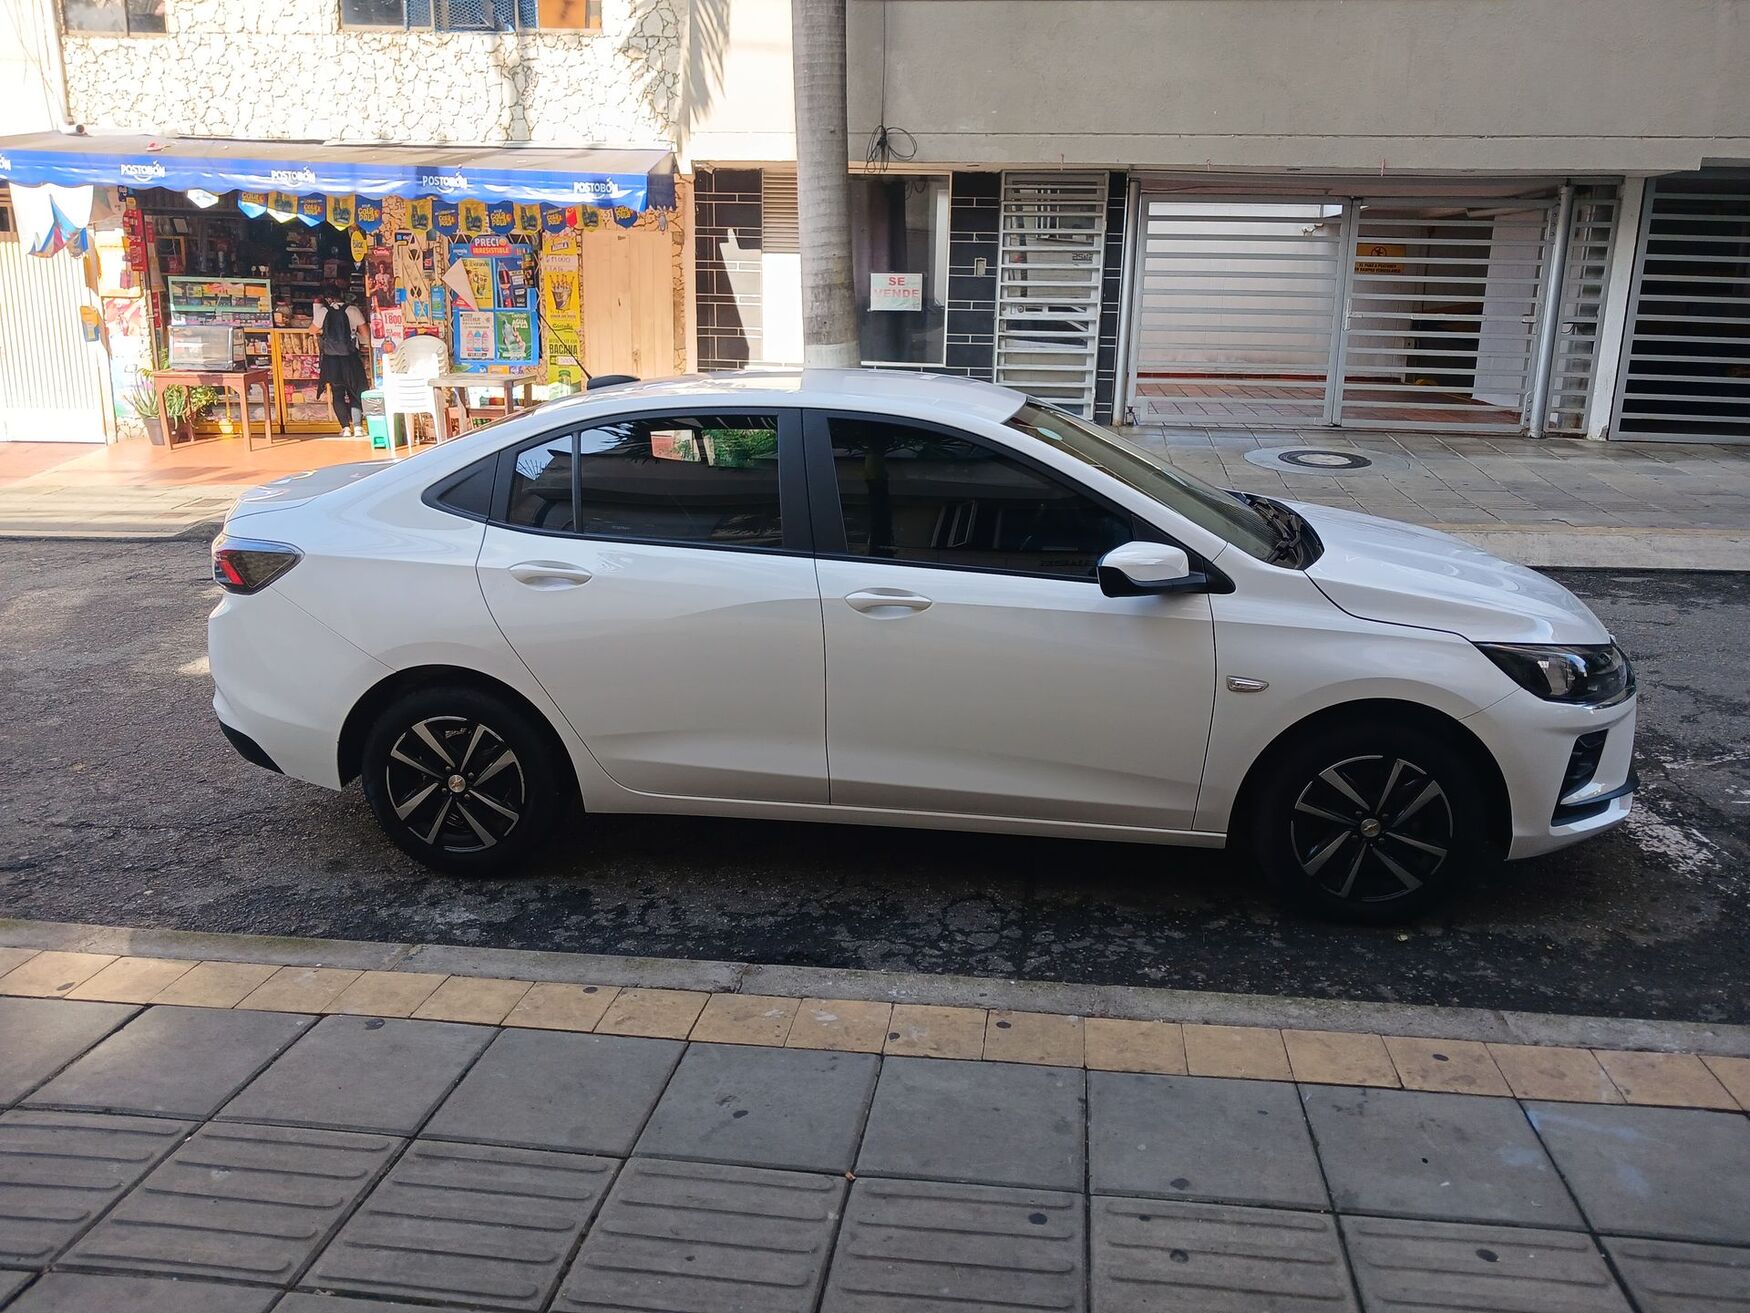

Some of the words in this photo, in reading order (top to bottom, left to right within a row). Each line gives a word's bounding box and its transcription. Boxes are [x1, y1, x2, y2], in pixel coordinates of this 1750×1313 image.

[120, 160, 166, 178] POSTOBÓN
[270, 166, 316, 184] POSTOBÓN
[422, 171, 468, 189] POSTOBÓN
[573, 177, 619, 193] POSTOBÓN
[474, 238, 507, 247] PRECIO
[888, 276, 906, 286] SE
[873, 289, 920, 298] VENDE
[549, 344, 578, 355] BACANA
